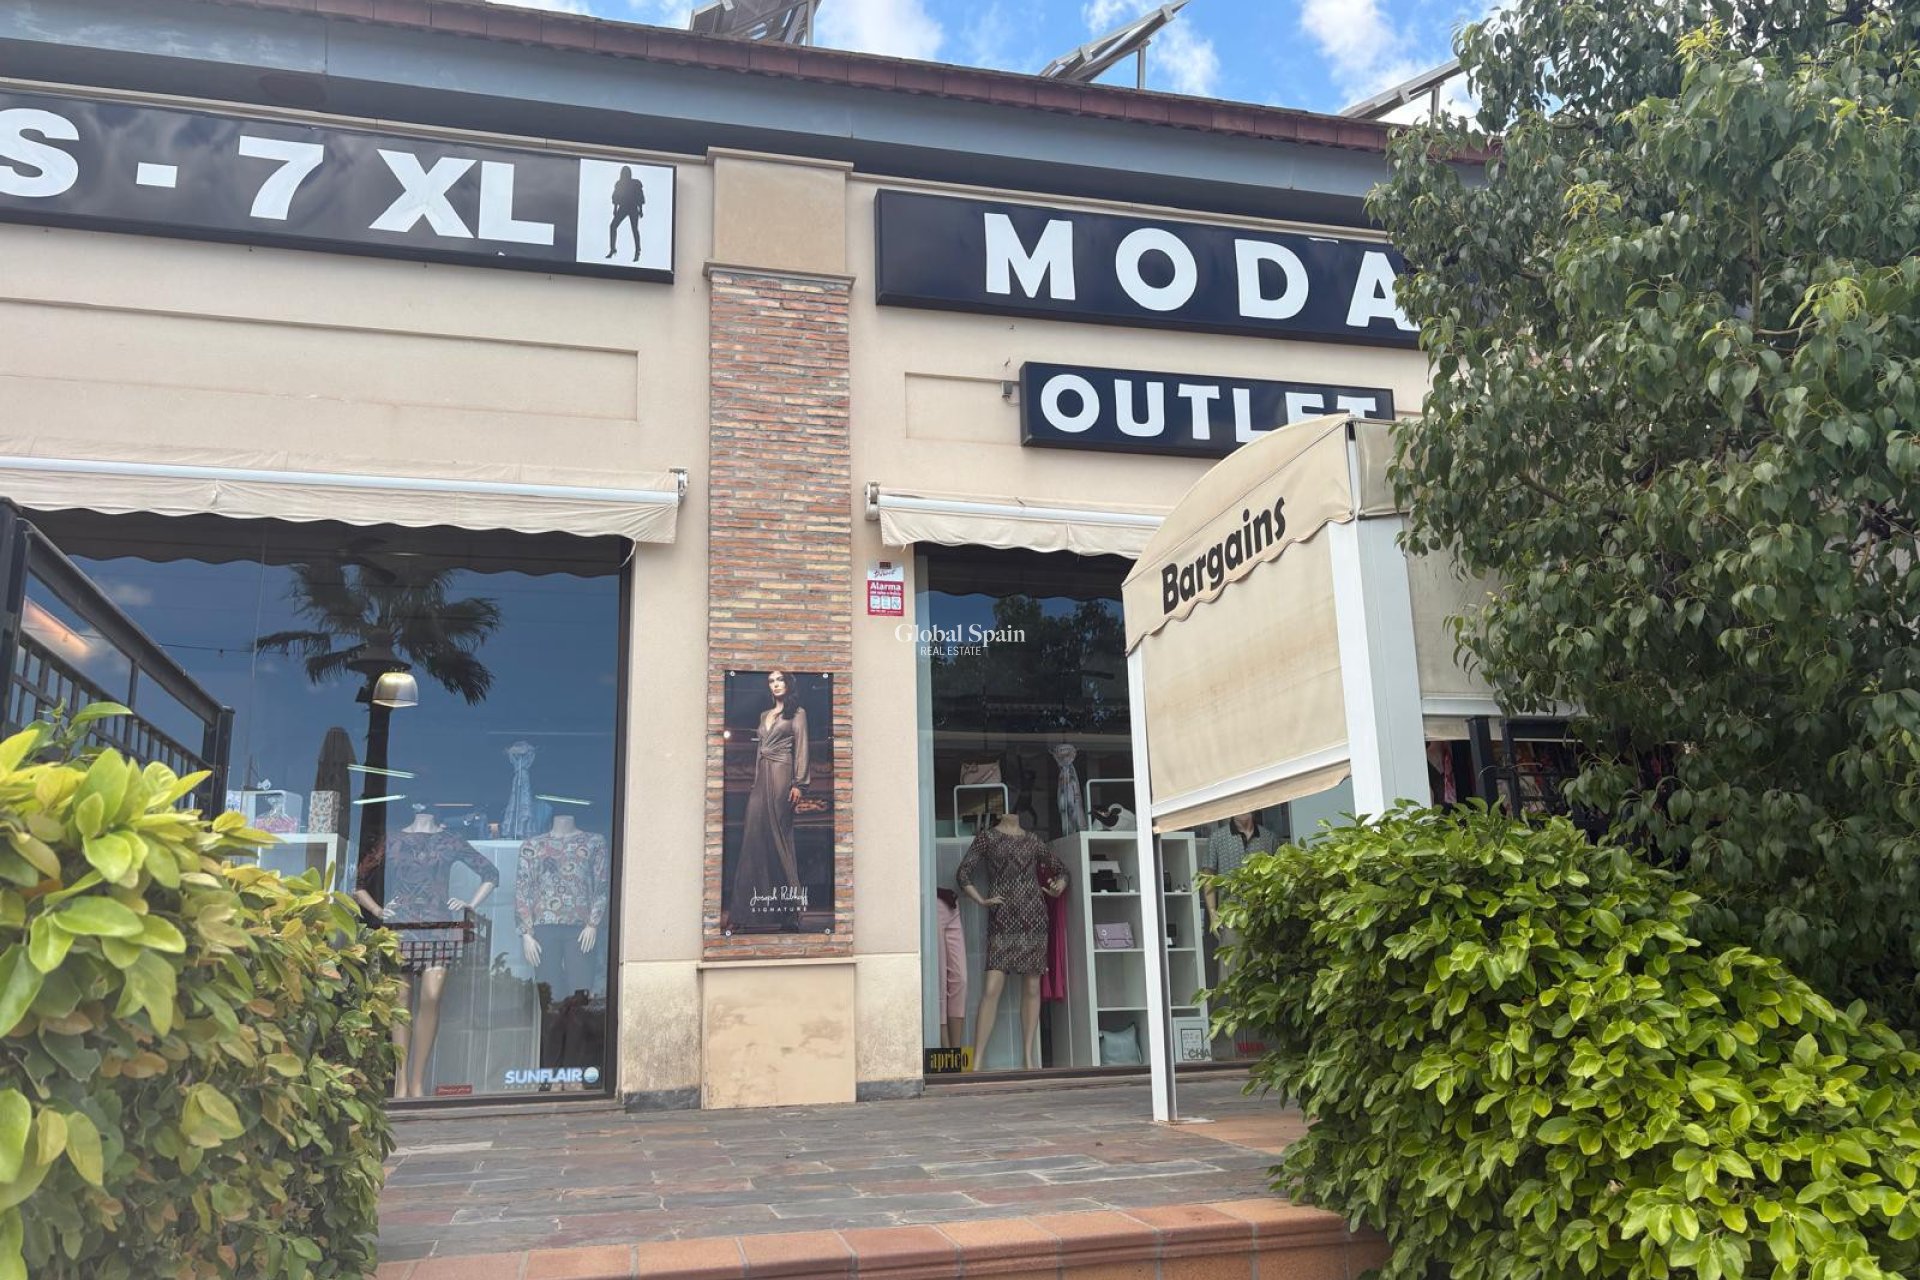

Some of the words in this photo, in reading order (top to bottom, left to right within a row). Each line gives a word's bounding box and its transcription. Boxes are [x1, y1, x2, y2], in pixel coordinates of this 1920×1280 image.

[238, 135, 325, 221] 7
[368, 148, 556, 246] XL
[984, 212, 1421, 331] MODA
[871, 582, 901, 591] Alarma
[1161, 496, 1286, 615] Bargains
[505, 1067, 583, 1084] SUNFLAIR
[930, 1049, 969, 1072] aprico
